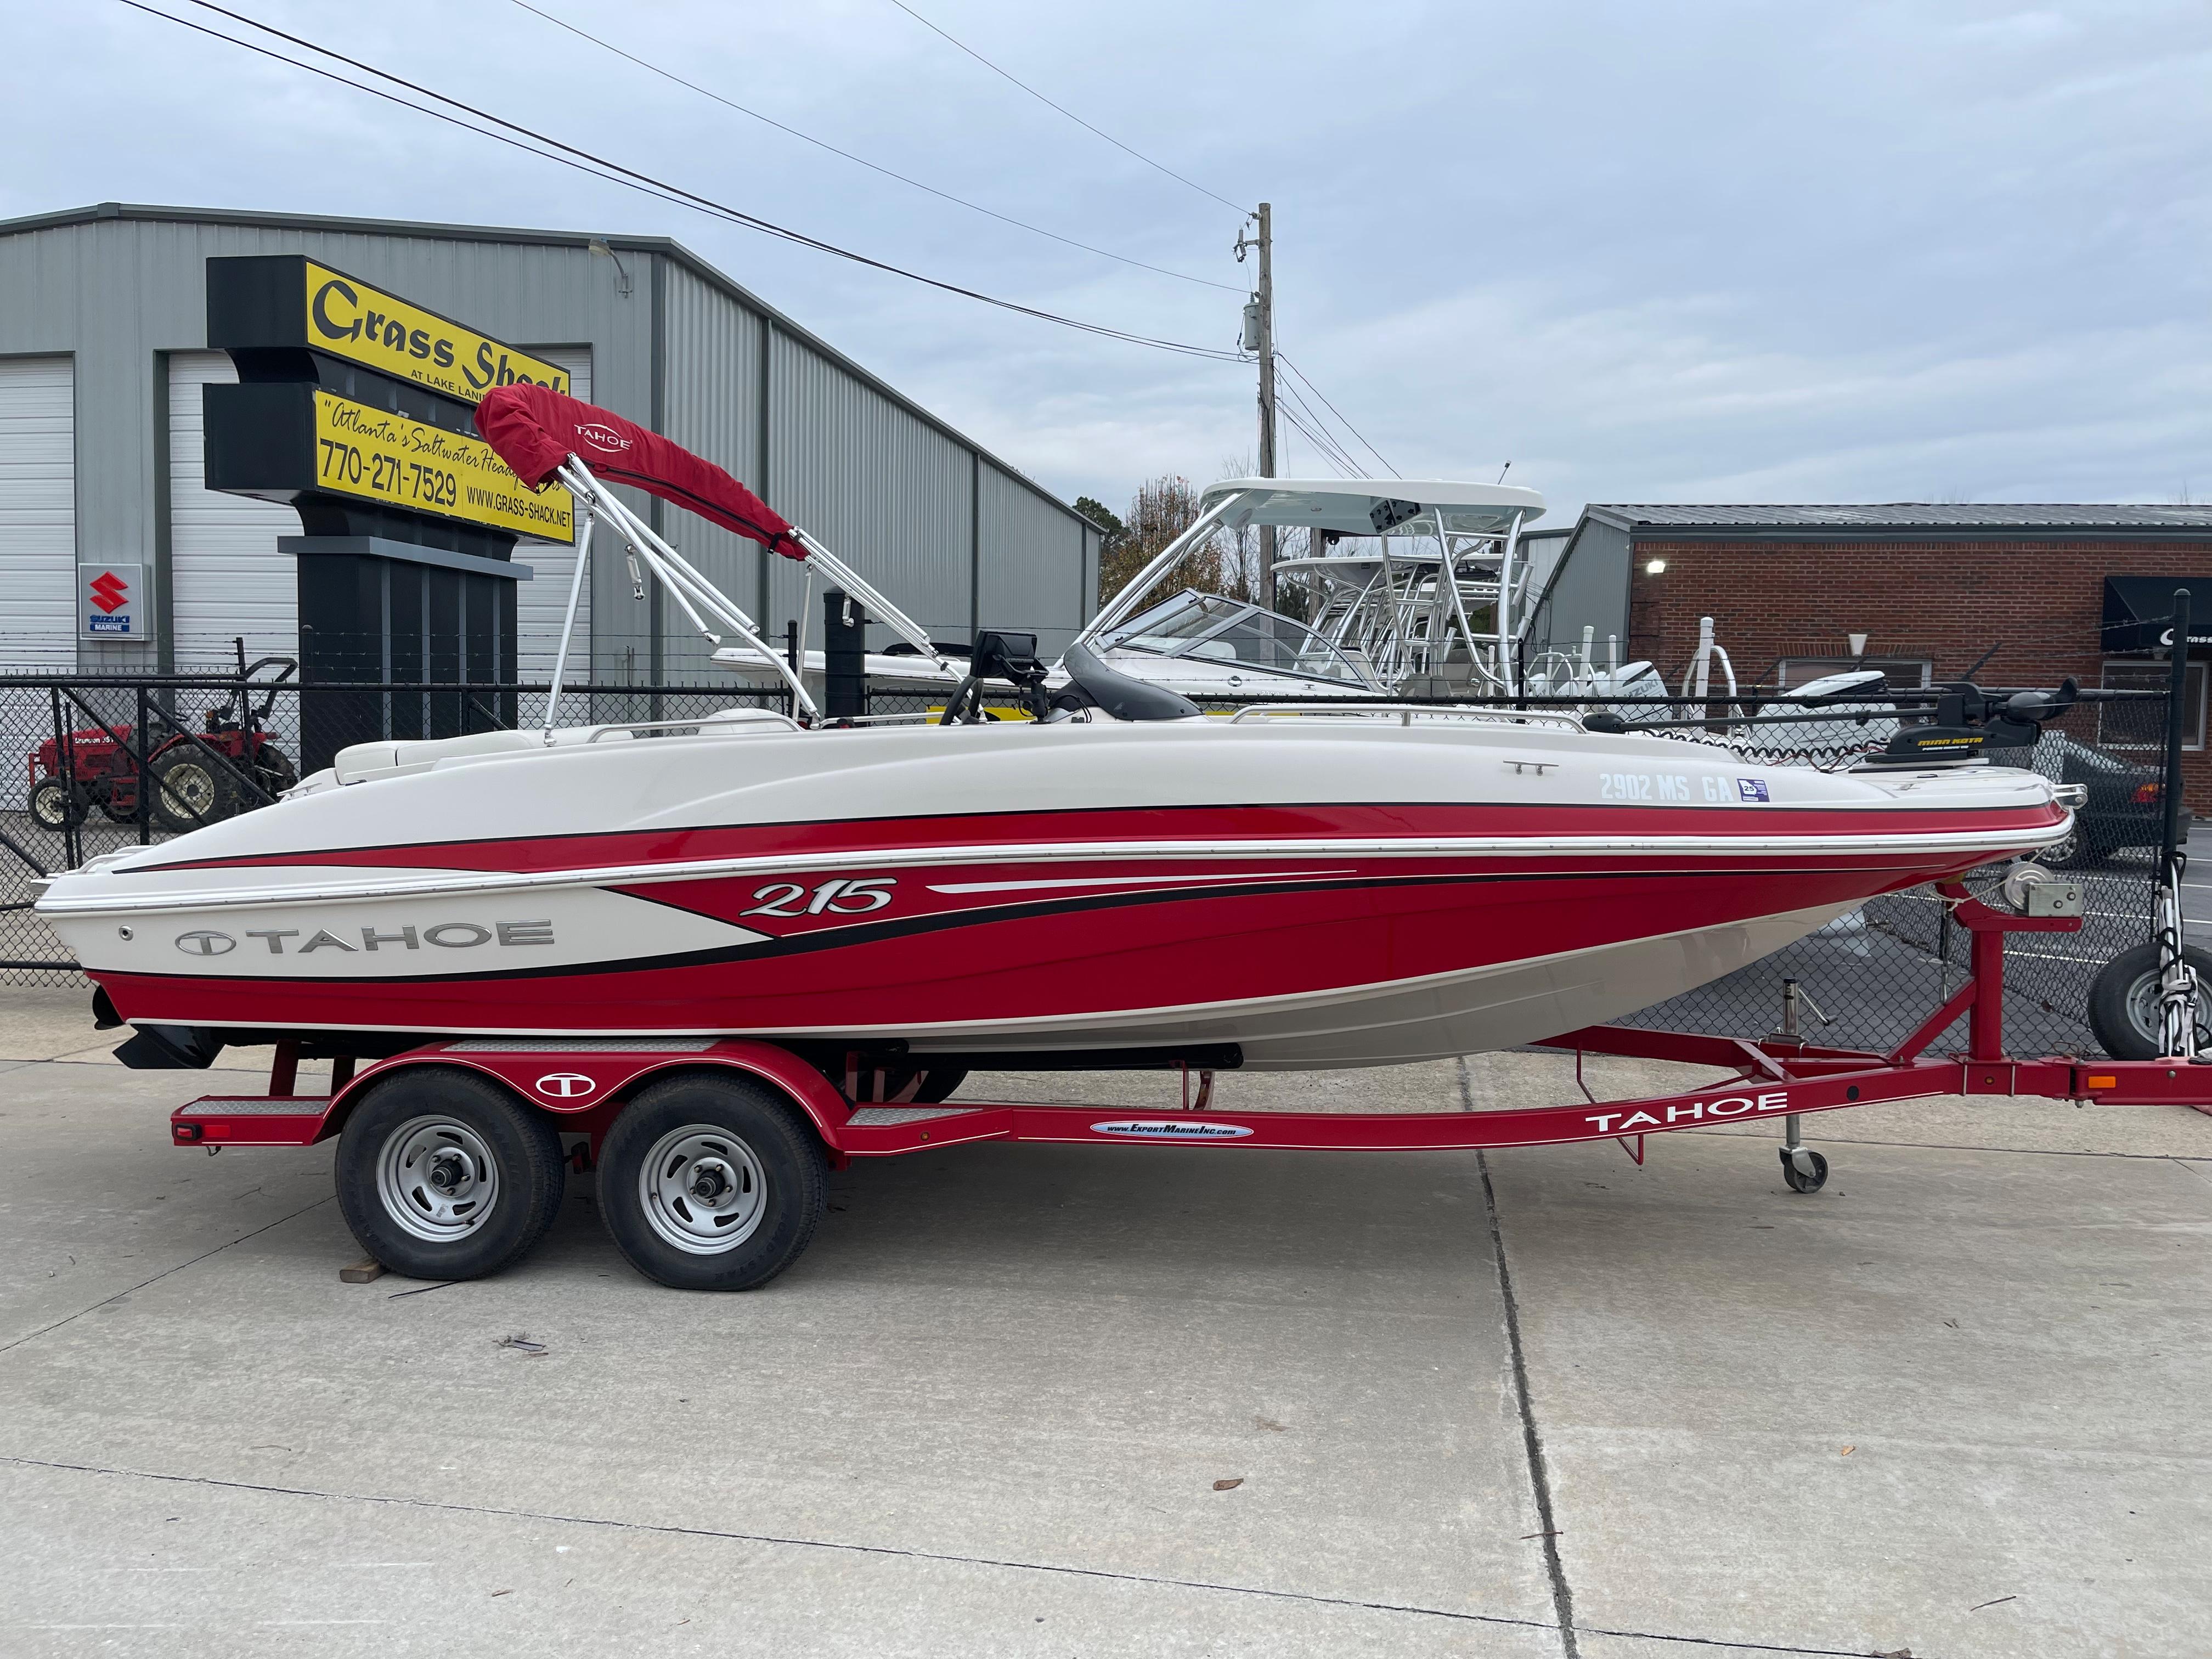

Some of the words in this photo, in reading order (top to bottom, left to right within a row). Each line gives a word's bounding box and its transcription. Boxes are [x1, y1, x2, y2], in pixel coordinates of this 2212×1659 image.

[313, 280, 454, 368] Grass
[411, 369, 423, 380] AT
[427, 374, 454, 392] LAKE
[459, 386, 485, 401] LANI
[411, 427, 479, 467] Saltwater
[573, 424, 631, 450] TAHOE
[320, 438, 456, 507] 770-271-7529
[466, 485, 571, 528] WWW.GRASS-SHACK.NET
[90, 614, 130, 624] SUZUKI
[1599, 773, 1653, 800] 2902
[1656, 774, 1690, 802] MS
[1702, 776, 1735, 802] GA
[738, 877, 898, 917] 215
[246, 919, 555, 953] TAHOE
[1585, 1092, 1788, 1132] TAHOE
